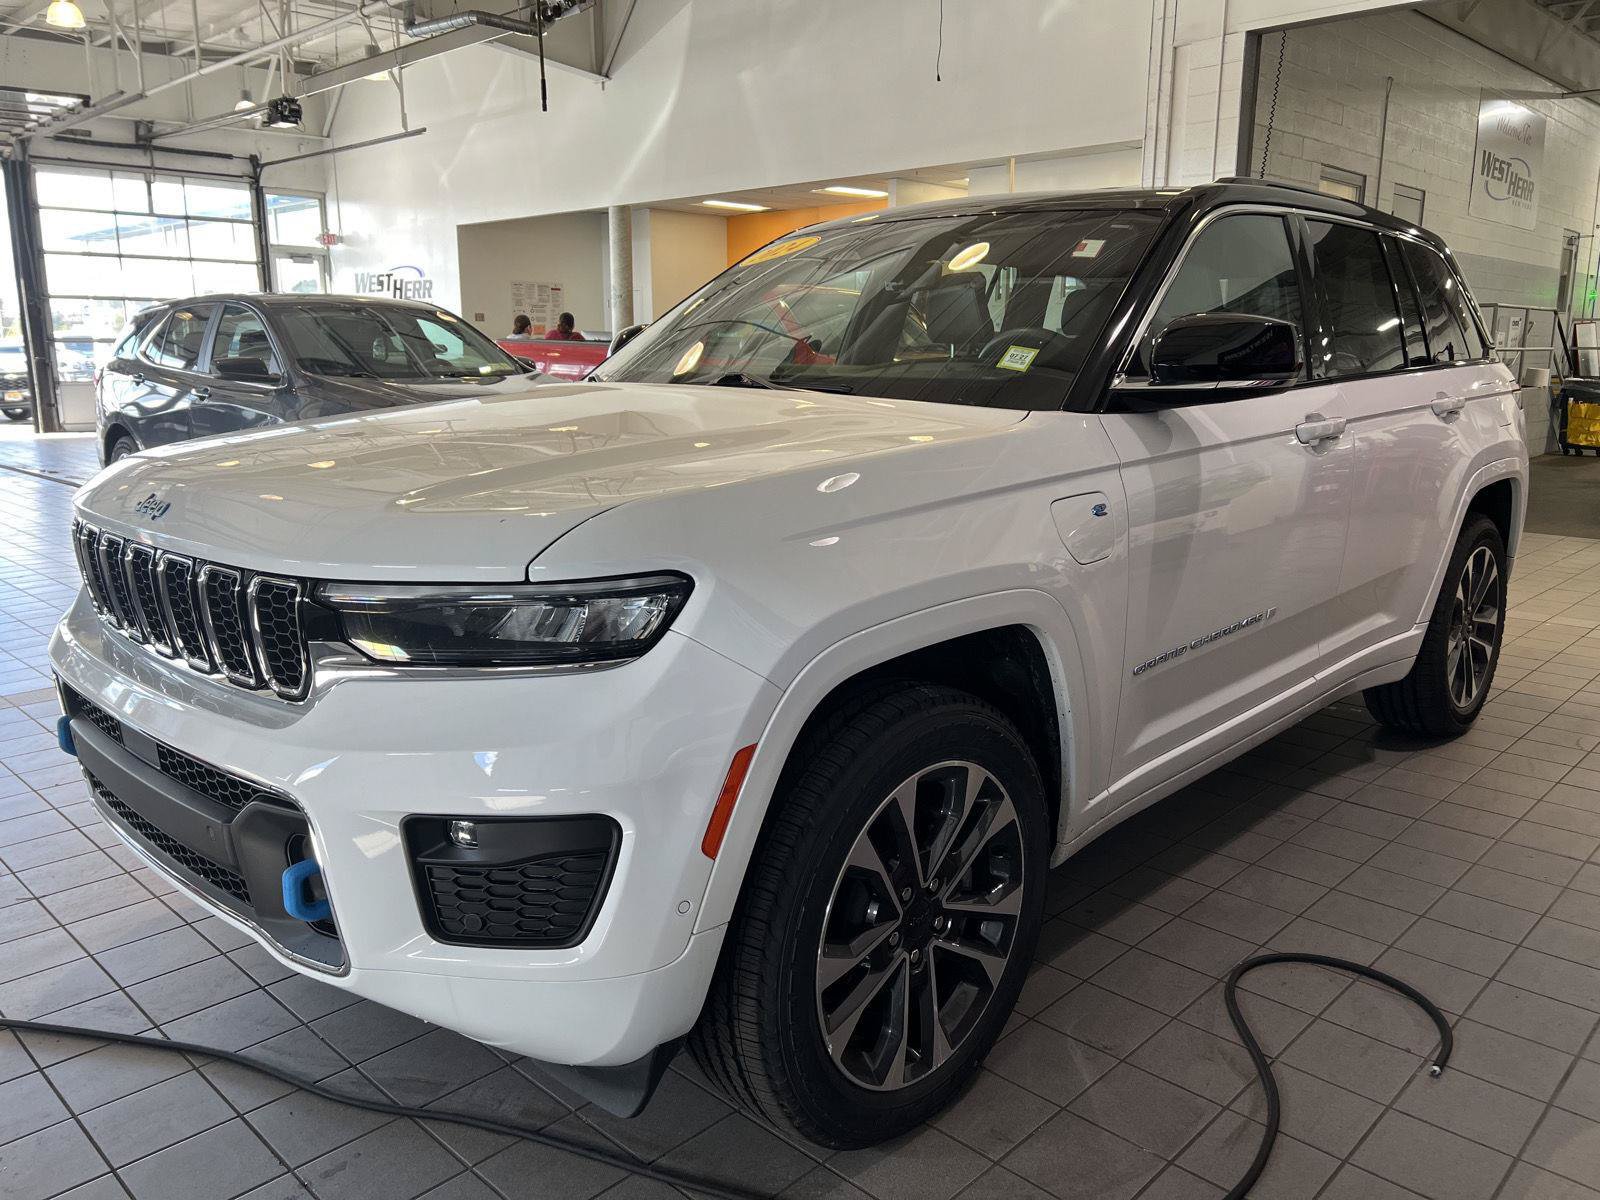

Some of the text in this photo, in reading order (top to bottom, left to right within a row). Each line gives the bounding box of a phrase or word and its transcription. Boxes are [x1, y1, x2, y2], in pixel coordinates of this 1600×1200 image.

[1481, 149, 1535, 203] WEST HERR
[354, 271, 433, 300] WEST HERR
[135, 493, 171, 521] Jeep
[1133, 612, 1264, 676] GRAND CHEROKEE
